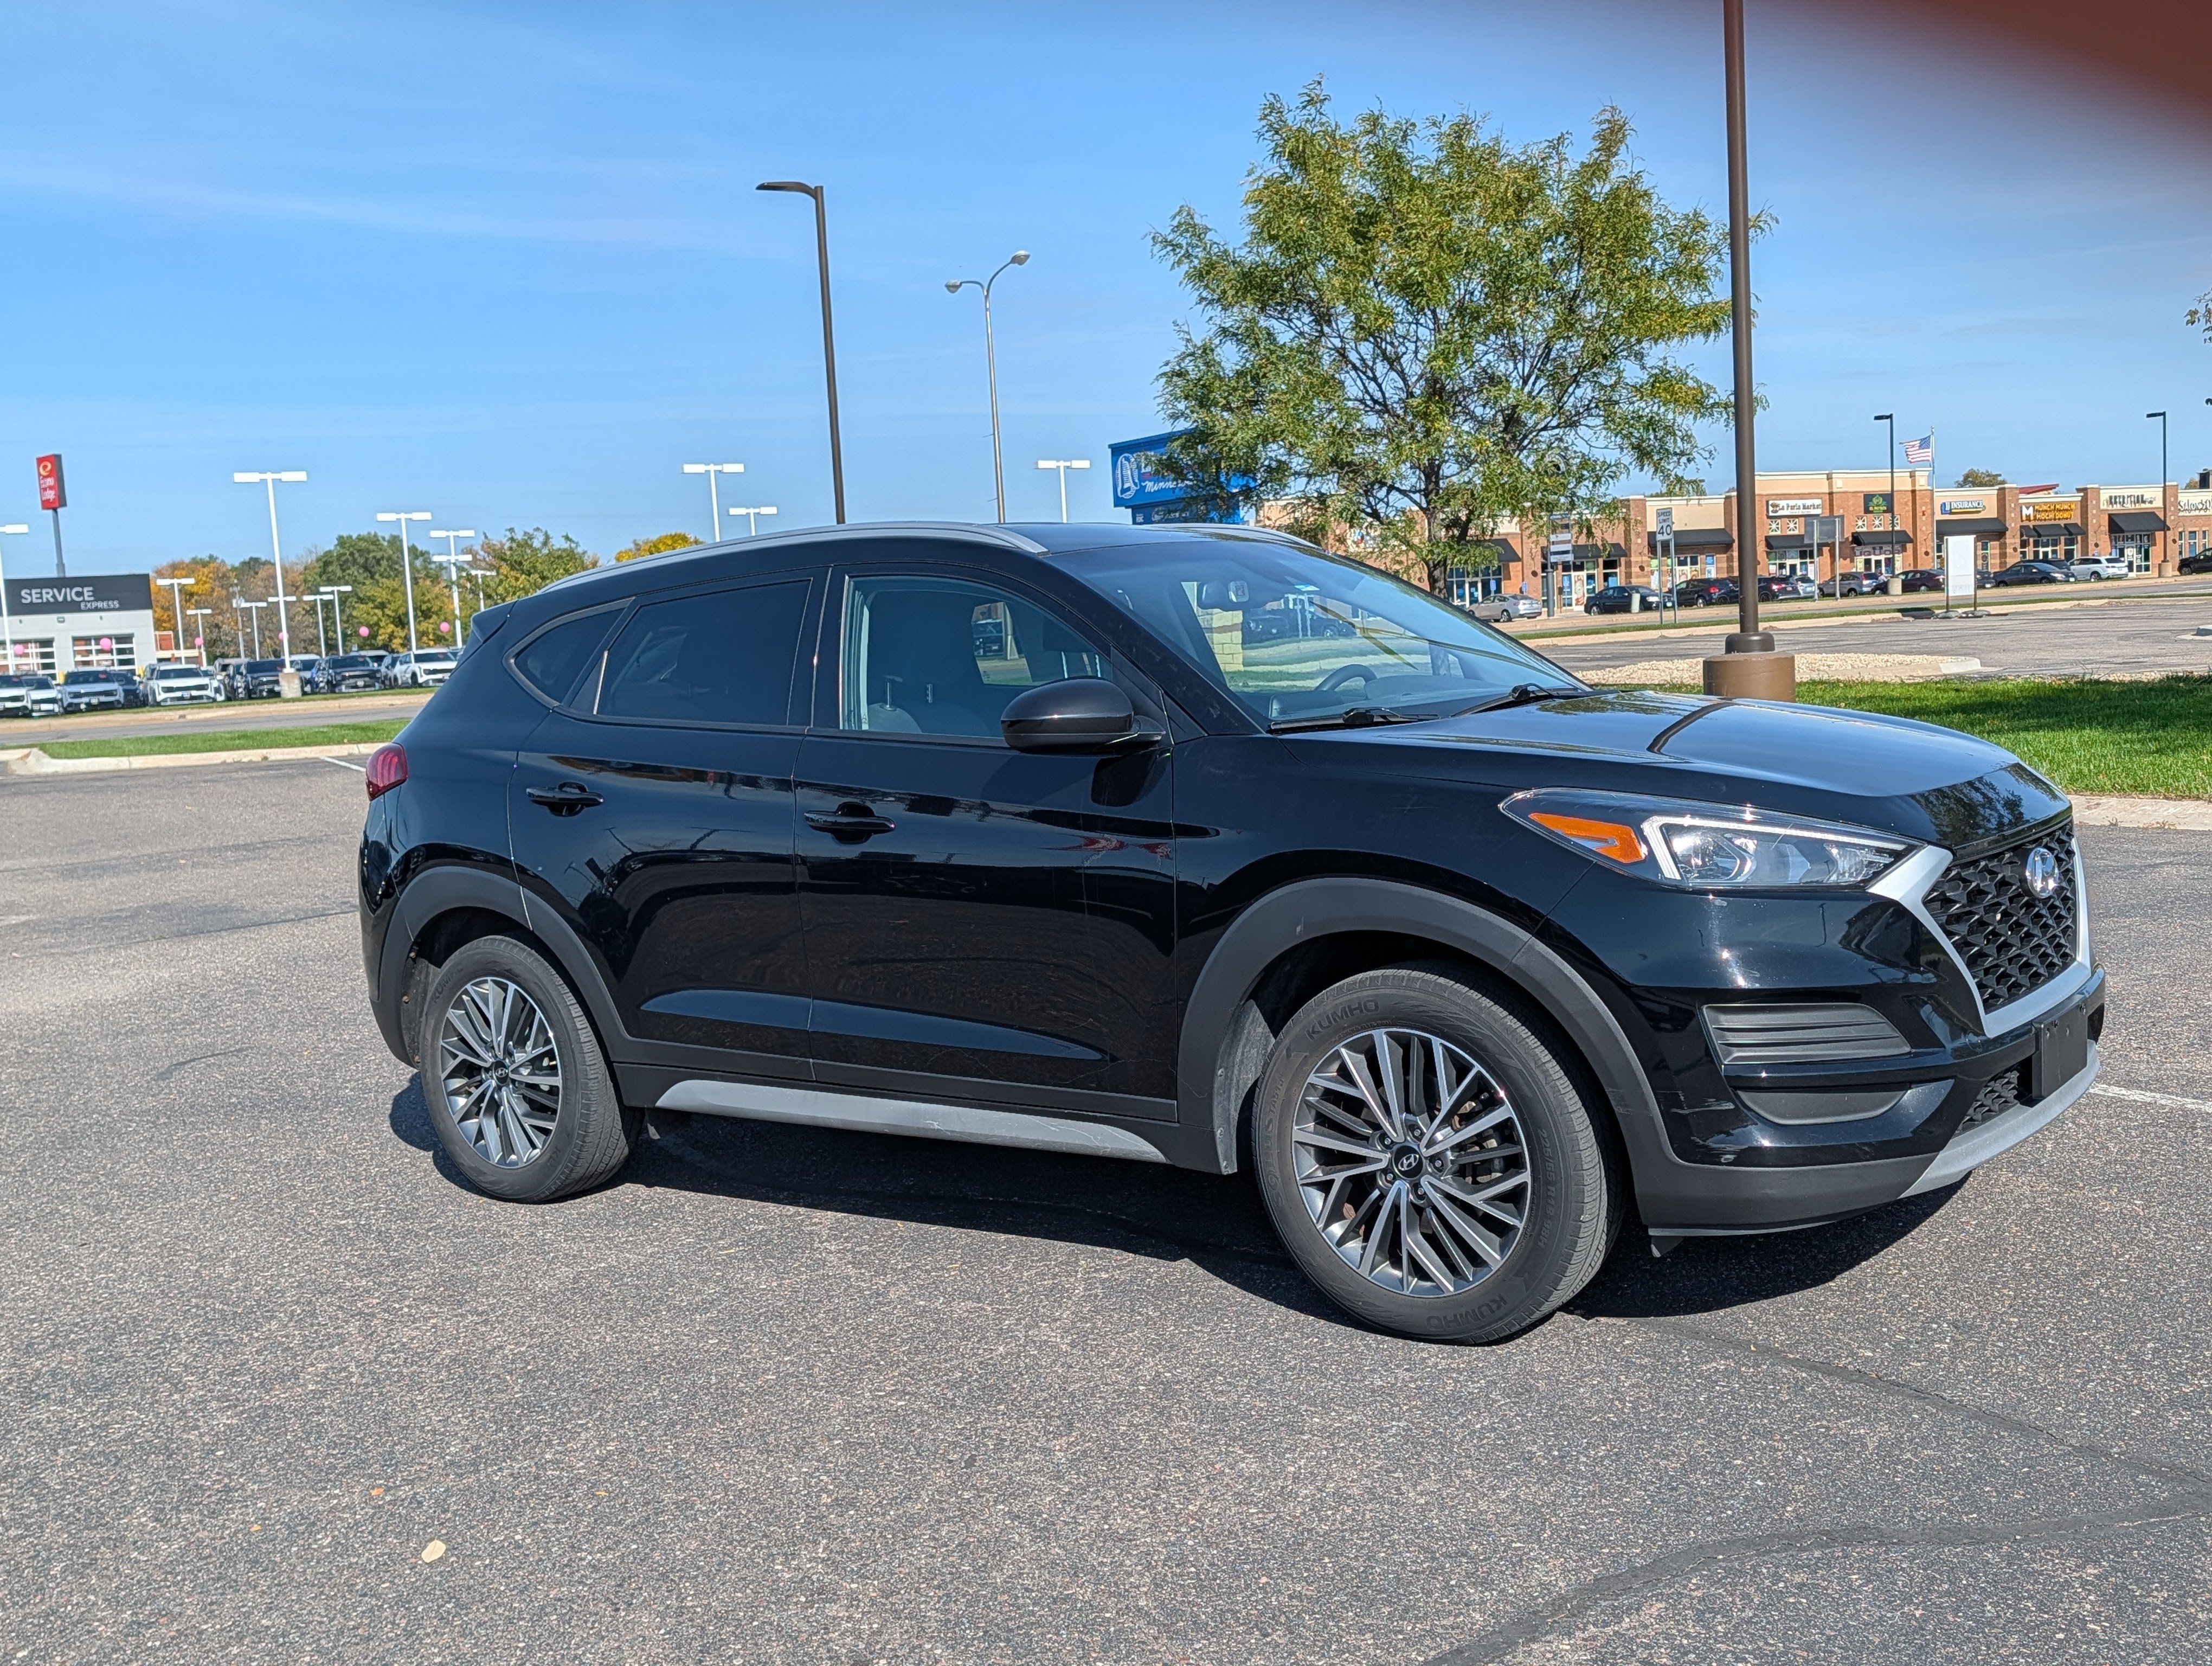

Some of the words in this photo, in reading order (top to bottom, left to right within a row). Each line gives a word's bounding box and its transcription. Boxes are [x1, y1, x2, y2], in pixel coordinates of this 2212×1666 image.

[1951, 501, 1983, 509] INSURANCE
[1658, 524, 1672, 536] 40
[21, 586, 94, 604] SERVICE
[80, 600, 120, 610] EXPRESS
[1305, 999, 1380, 1041] KUMHO
[1538, 1128, 1555, 1182] 225/55
[1546, 1186, 1555, 1216] R18
[1426, 1293, 1508, 1330] KUMHO
